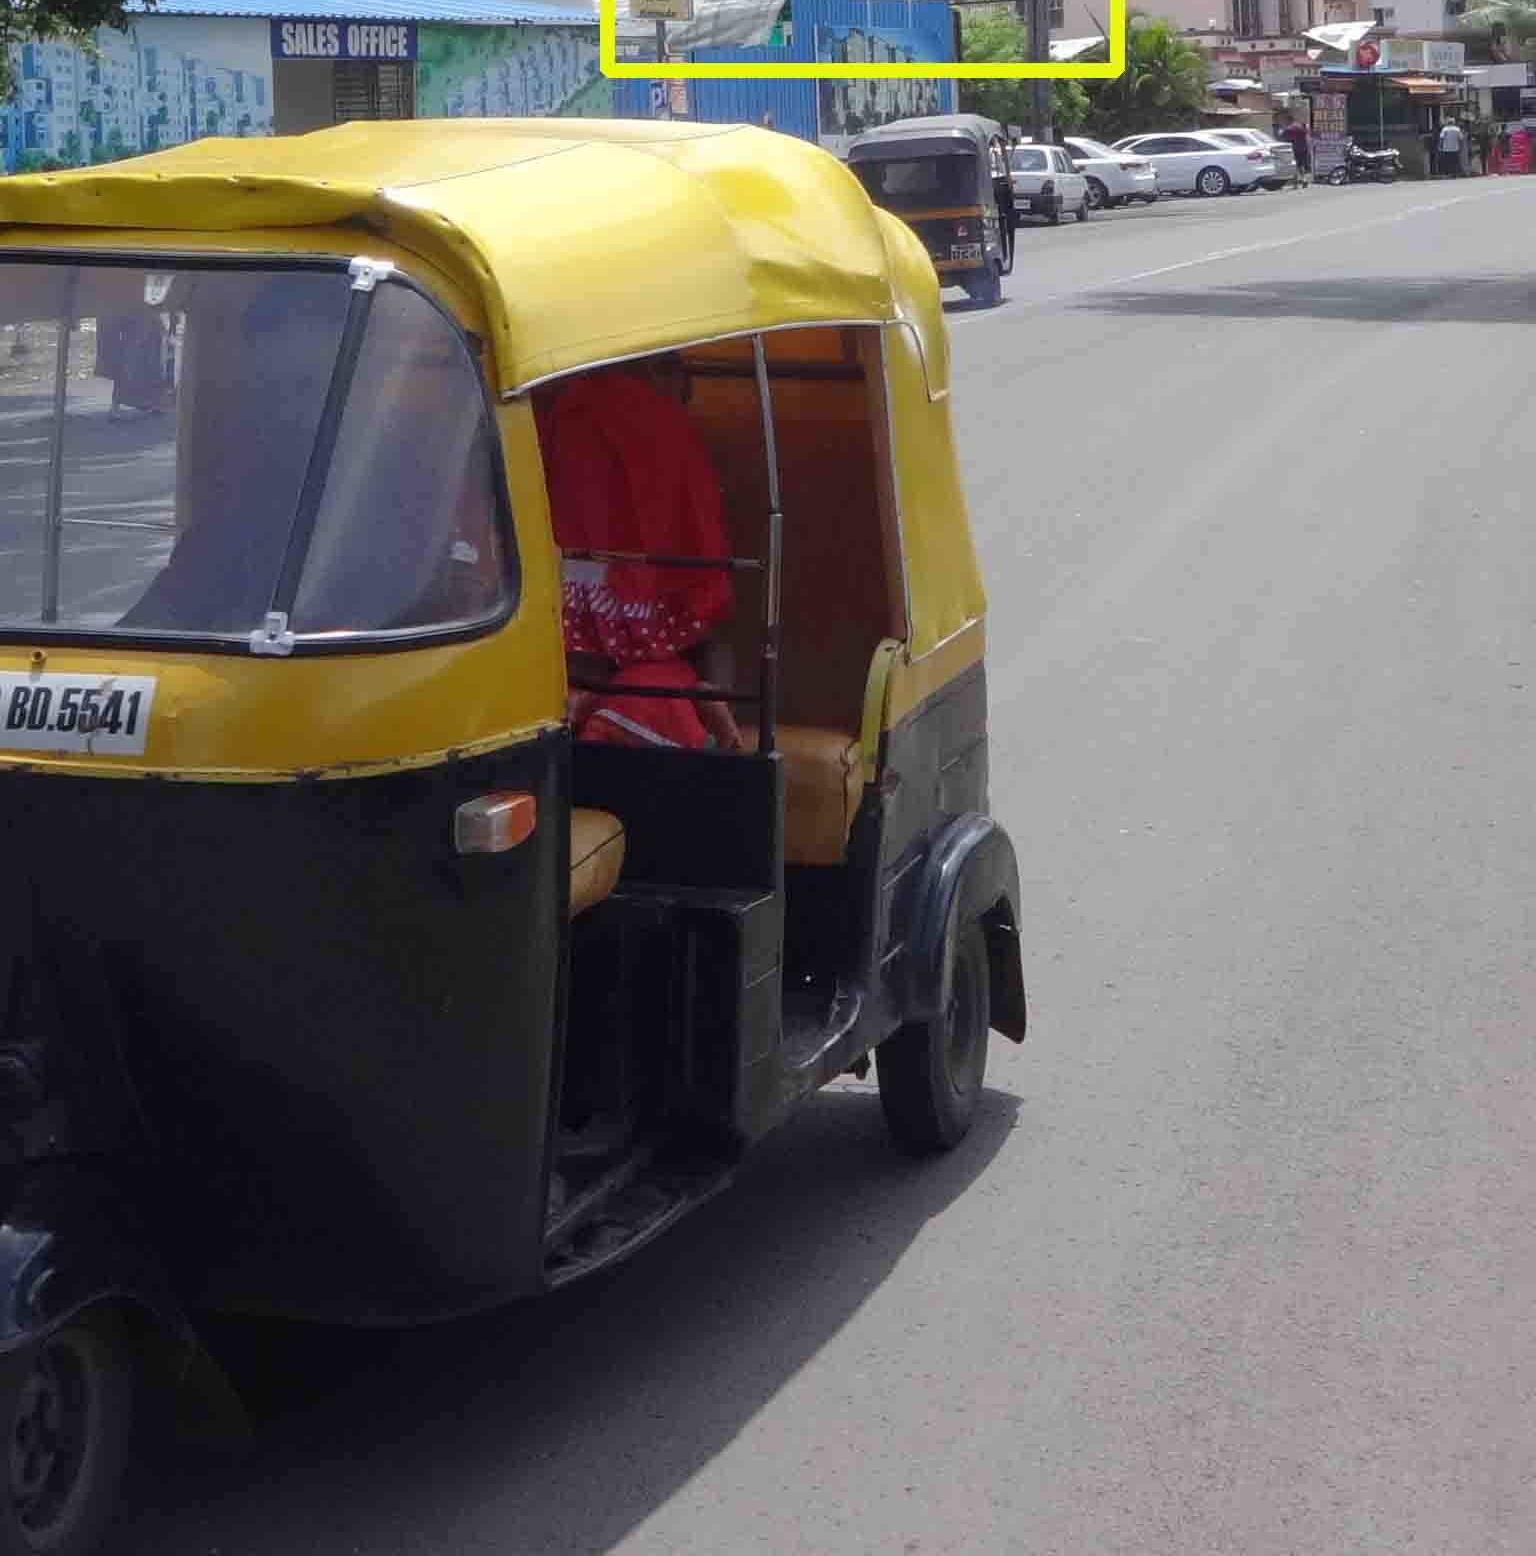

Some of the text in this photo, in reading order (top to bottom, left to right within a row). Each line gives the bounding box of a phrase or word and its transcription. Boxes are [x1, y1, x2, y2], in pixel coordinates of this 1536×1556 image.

[281, 22, 408, 57] SALES OFFICE
[4, 687, 143, 736] BD.5541
